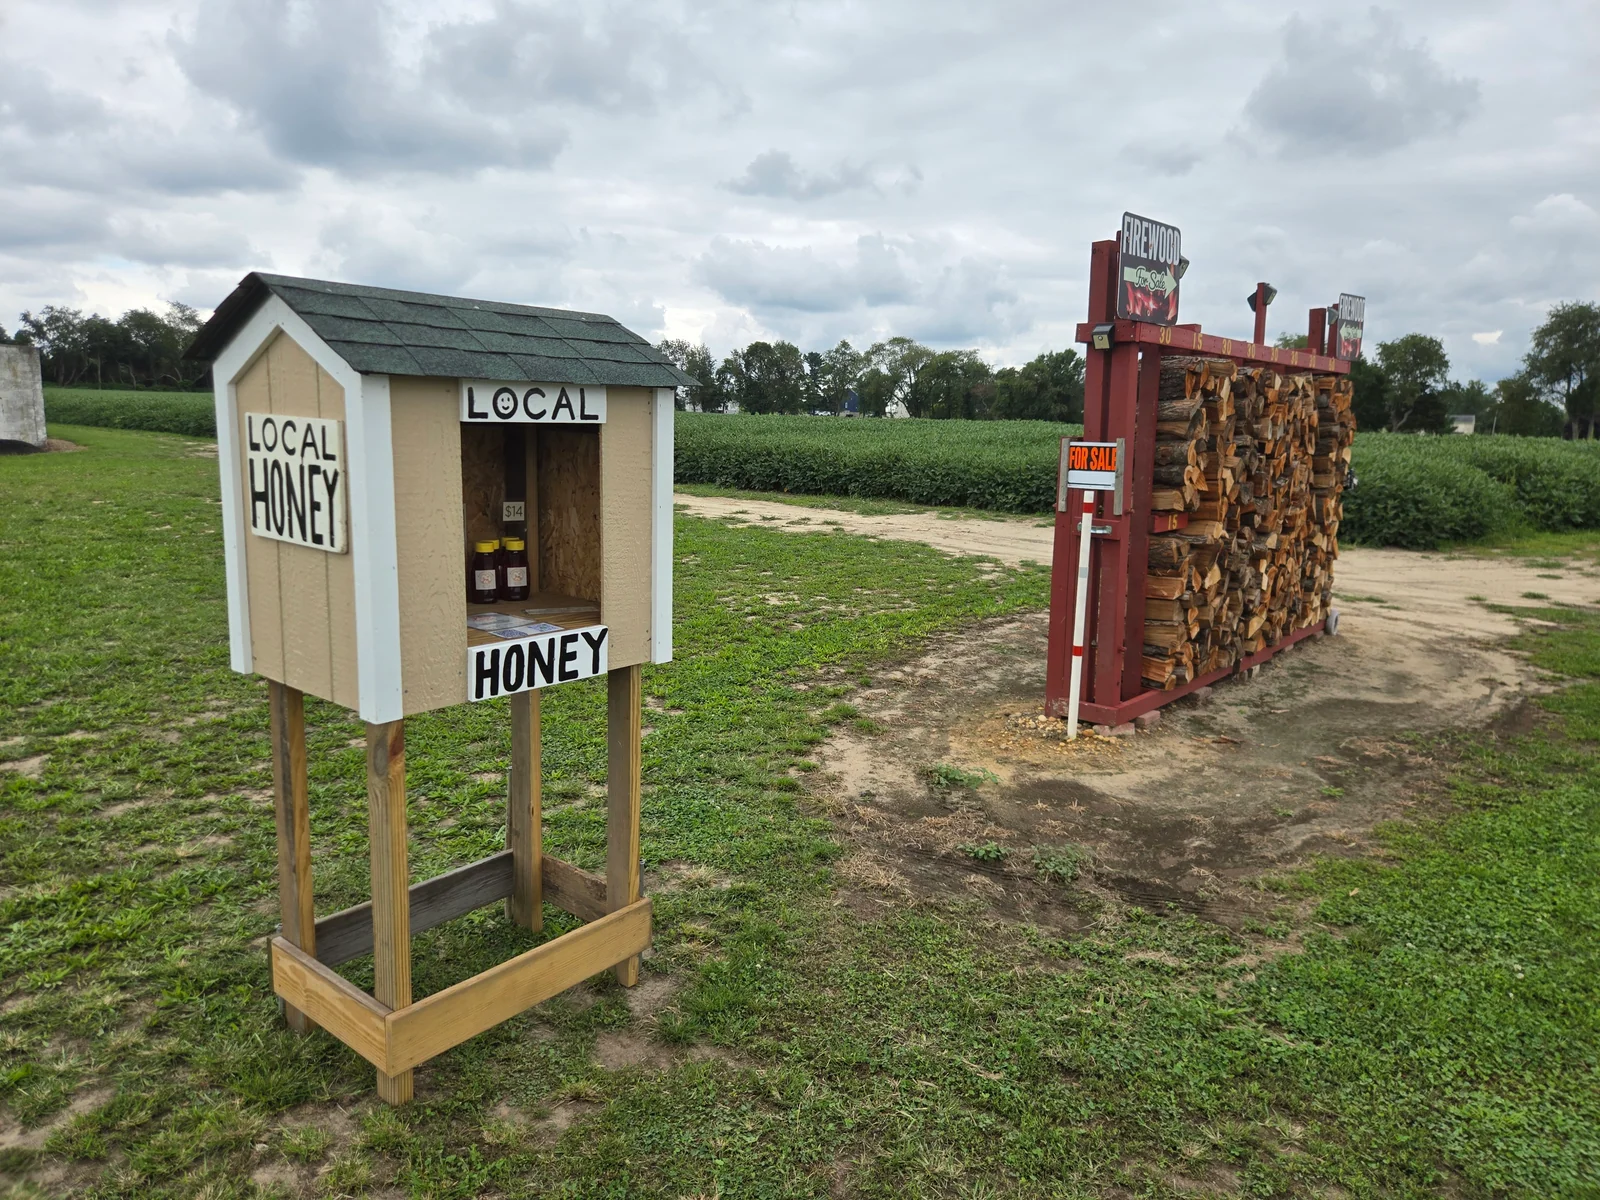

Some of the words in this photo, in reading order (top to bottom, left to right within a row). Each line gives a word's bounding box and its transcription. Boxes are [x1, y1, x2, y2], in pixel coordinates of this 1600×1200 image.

[1122, 215, 1180, 266] FIREWOOD
[1135, 266, 1148, 286] For
[1148, 271, 1166, 291] Sale
[1159, 326, 1172, 345] 30
[1192, 332, 1203, 350] 15
[1221, 338, 1232, 355] 30
[1246, 343, 1256, 359] 30
[467, 386, 599, 421] LOCAL
[248, 415, 336, 461] LOCAL
[1069, 446, 1089, 470] FOR
[1089, 446, 1117, 471] SALE
[249, 457, 339, 549] HONEY
[504, 505, 523, 518] $14
[1167, 514, 1178, 530] 15
[475, 627, 609, 700] HONEY
